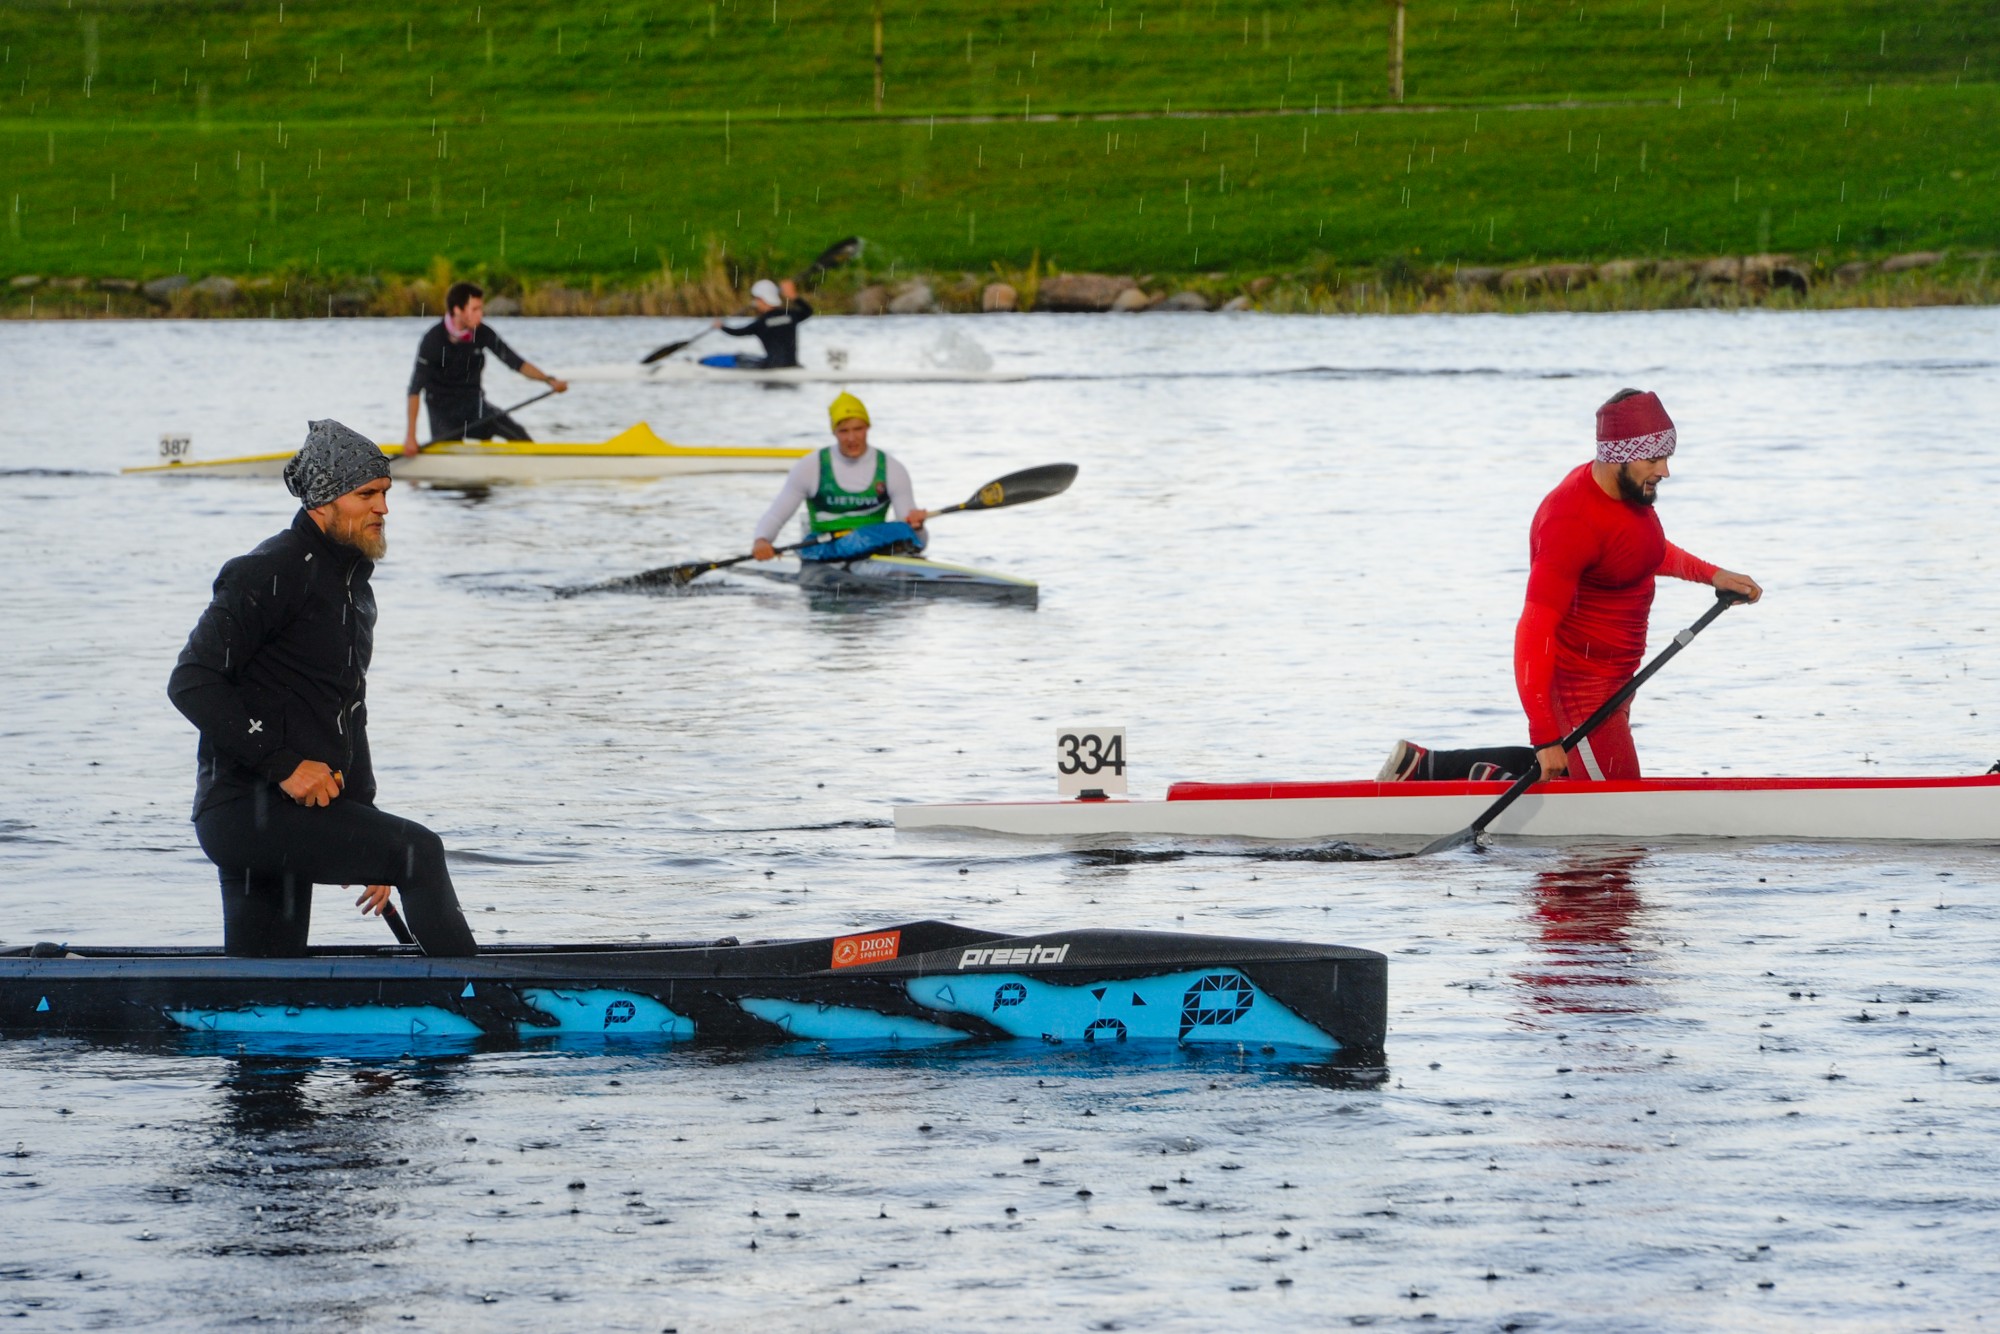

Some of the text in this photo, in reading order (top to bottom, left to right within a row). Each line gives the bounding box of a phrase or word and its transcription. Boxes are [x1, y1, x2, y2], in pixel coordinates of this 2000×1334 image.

[160, 439, 190, 457] 387
[826, 495, 879, 506] LIETUVA
[1058, 734, 1126, 776] 334
[860, 936, 896, 951] DION
[859, 949, 893, 959] SPORTLAB
